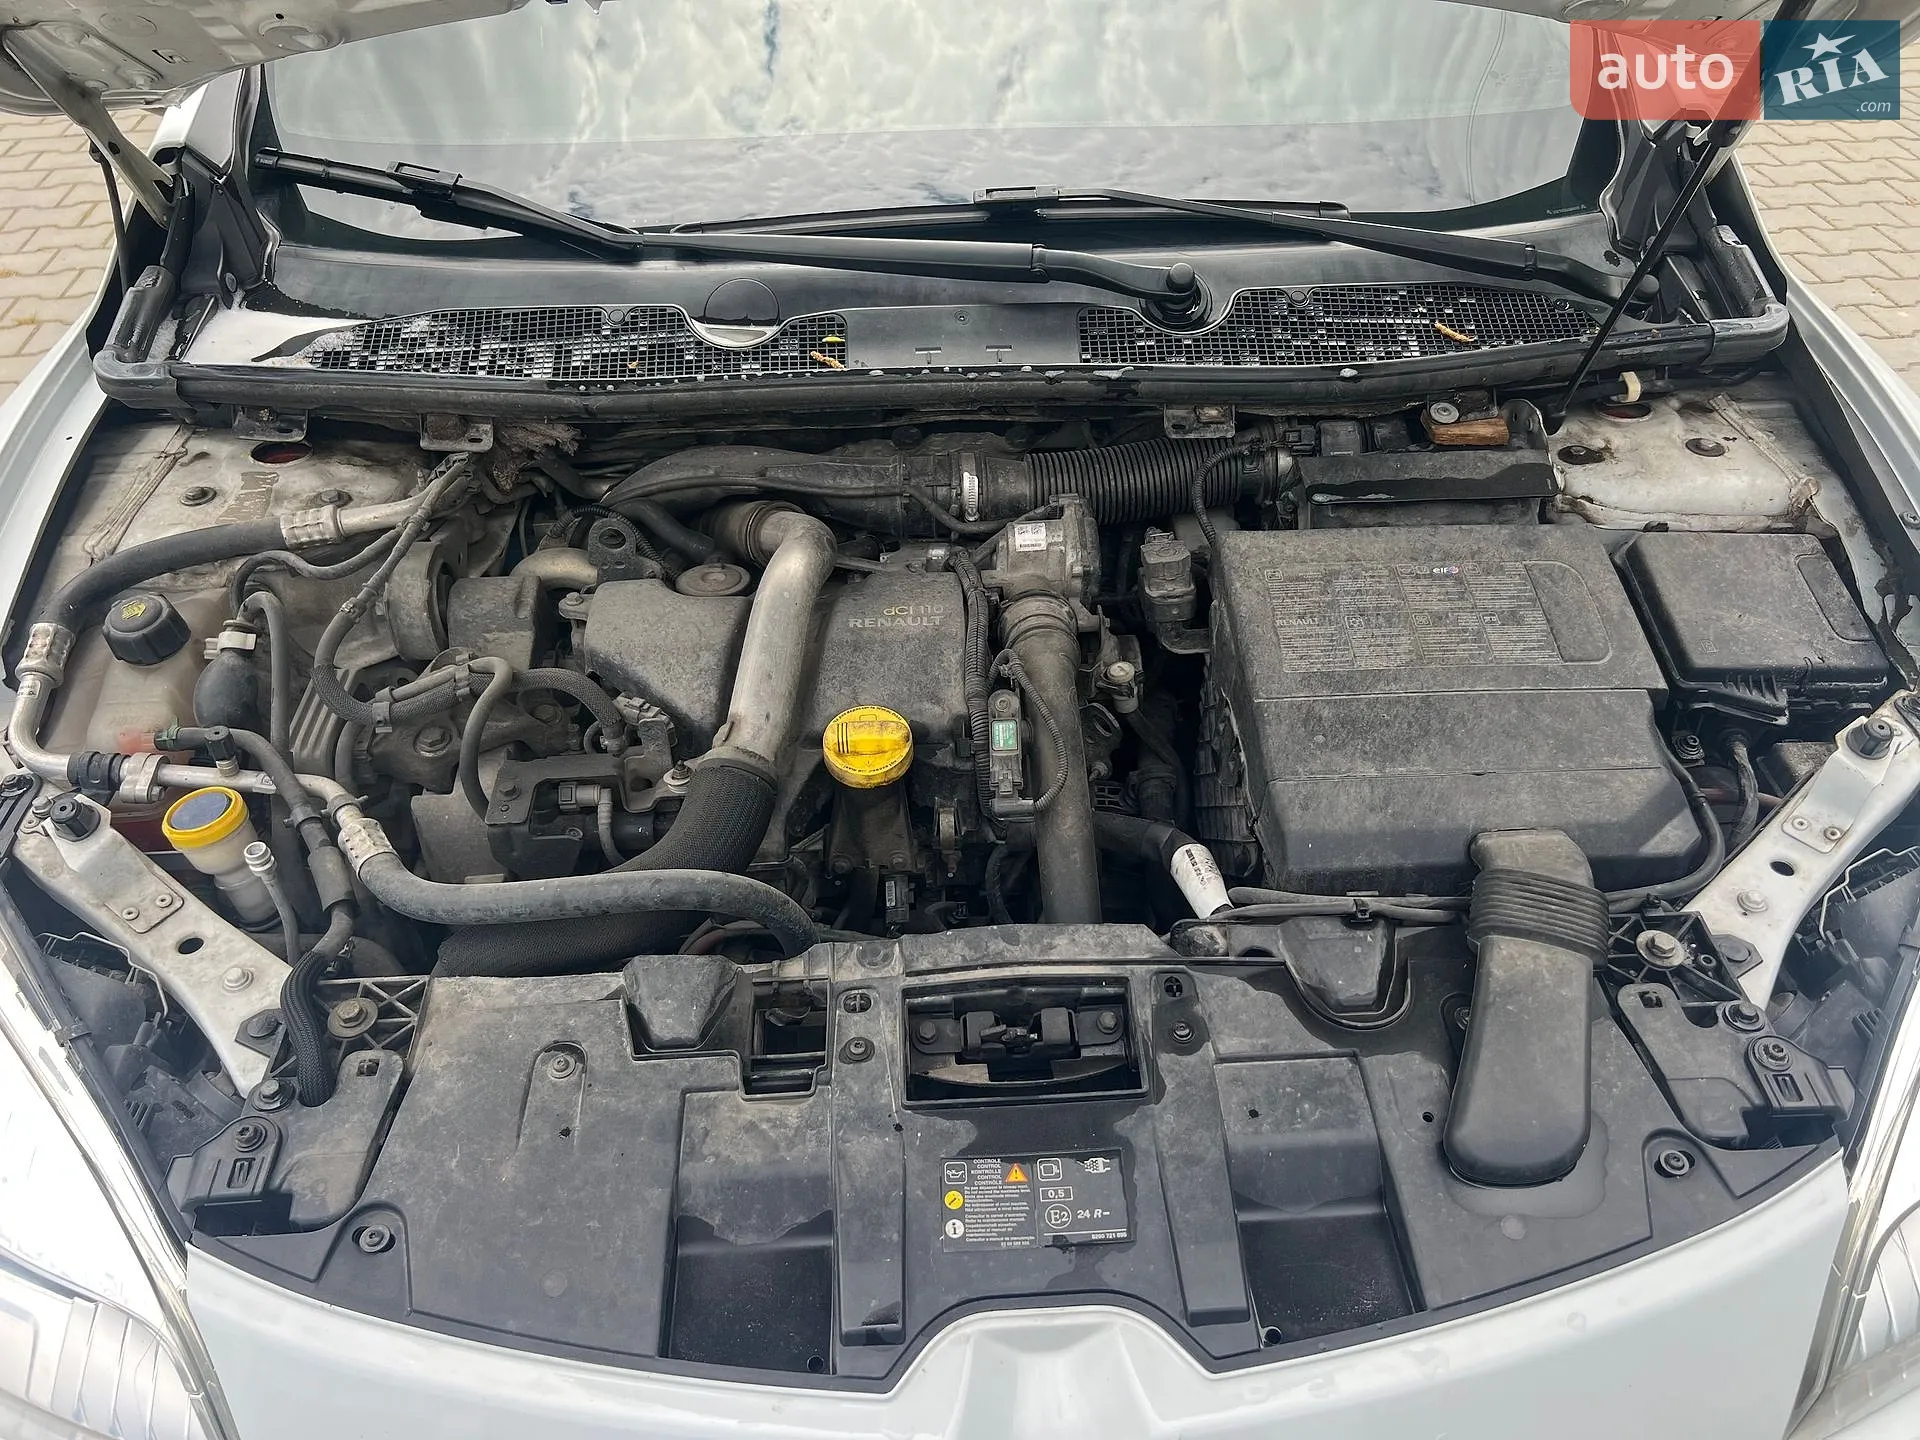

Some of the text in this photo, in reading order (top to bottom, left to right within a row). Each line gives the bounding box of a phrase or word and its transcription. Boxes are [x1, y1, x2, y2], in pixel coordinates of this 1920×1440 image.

[847, 615, 945, 629] RENAULT
[1048, 1189, 1065, 1198] 0,5
[1049, 1210, 1070, 1224] E2
[1077, 1209, 1091, 1219] 24
